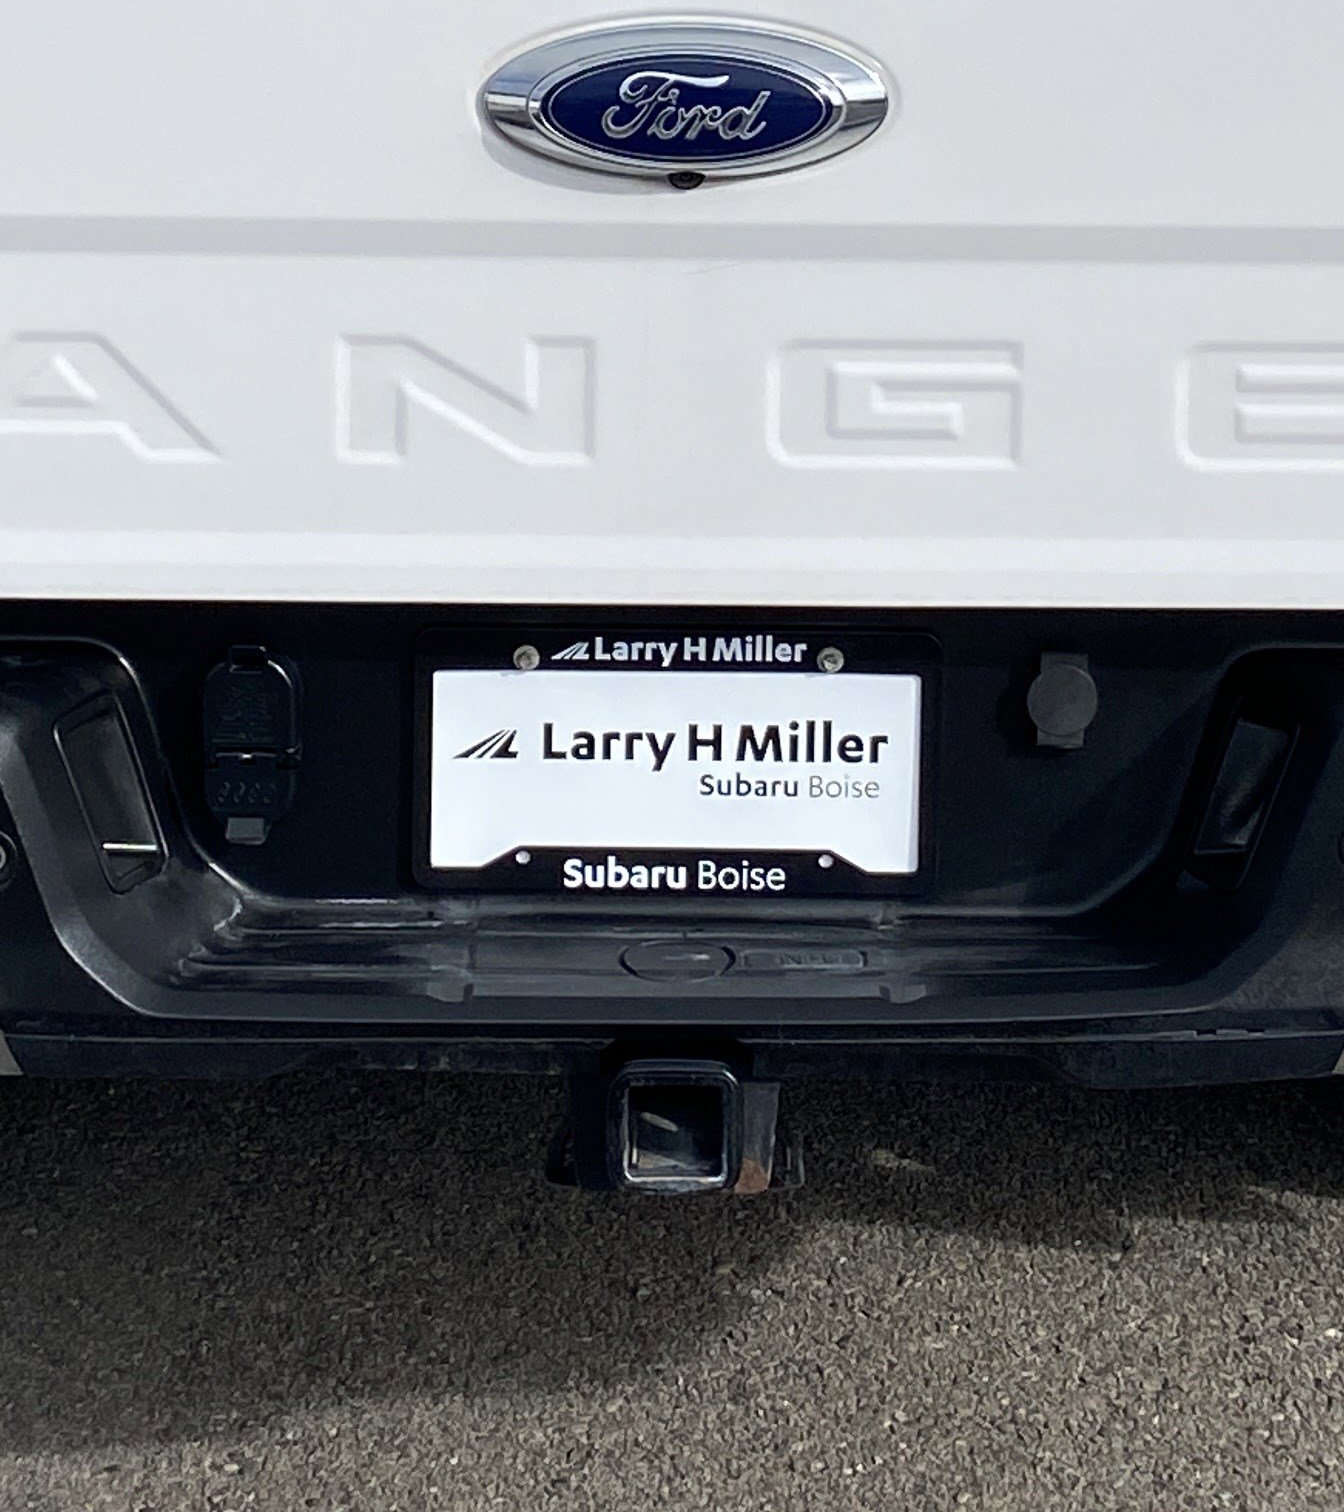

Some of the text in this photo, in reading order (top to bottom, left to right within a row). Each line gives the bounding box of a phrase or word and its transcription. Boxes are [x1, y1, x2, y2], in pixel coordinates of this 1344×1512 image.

[601, 70, 770, 142] Ford
[594, 635, 808, 668] Larry H Miller
[542, 720, 889, 772] Larry H Miller
[699, 772, 881, 799] Subaru Boise
[563, 855, 786, 890] Subaru Boise
